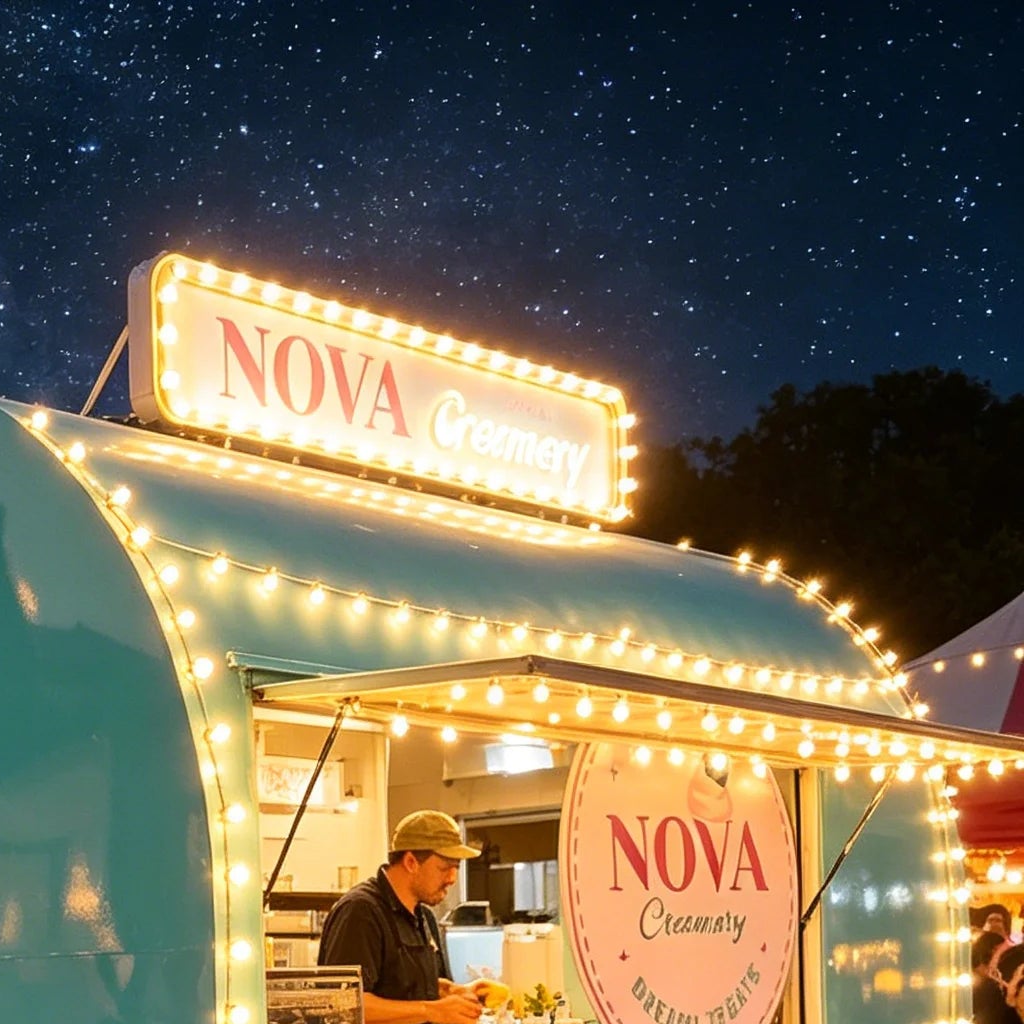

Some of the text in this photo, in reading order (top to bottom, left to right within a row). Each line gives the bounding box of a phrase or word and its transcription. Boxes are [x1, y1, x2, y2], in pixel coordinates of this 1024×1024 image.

[216, 317, 590, 488] NOVA Creamery
[606, 815, 769, 893] NOVA
